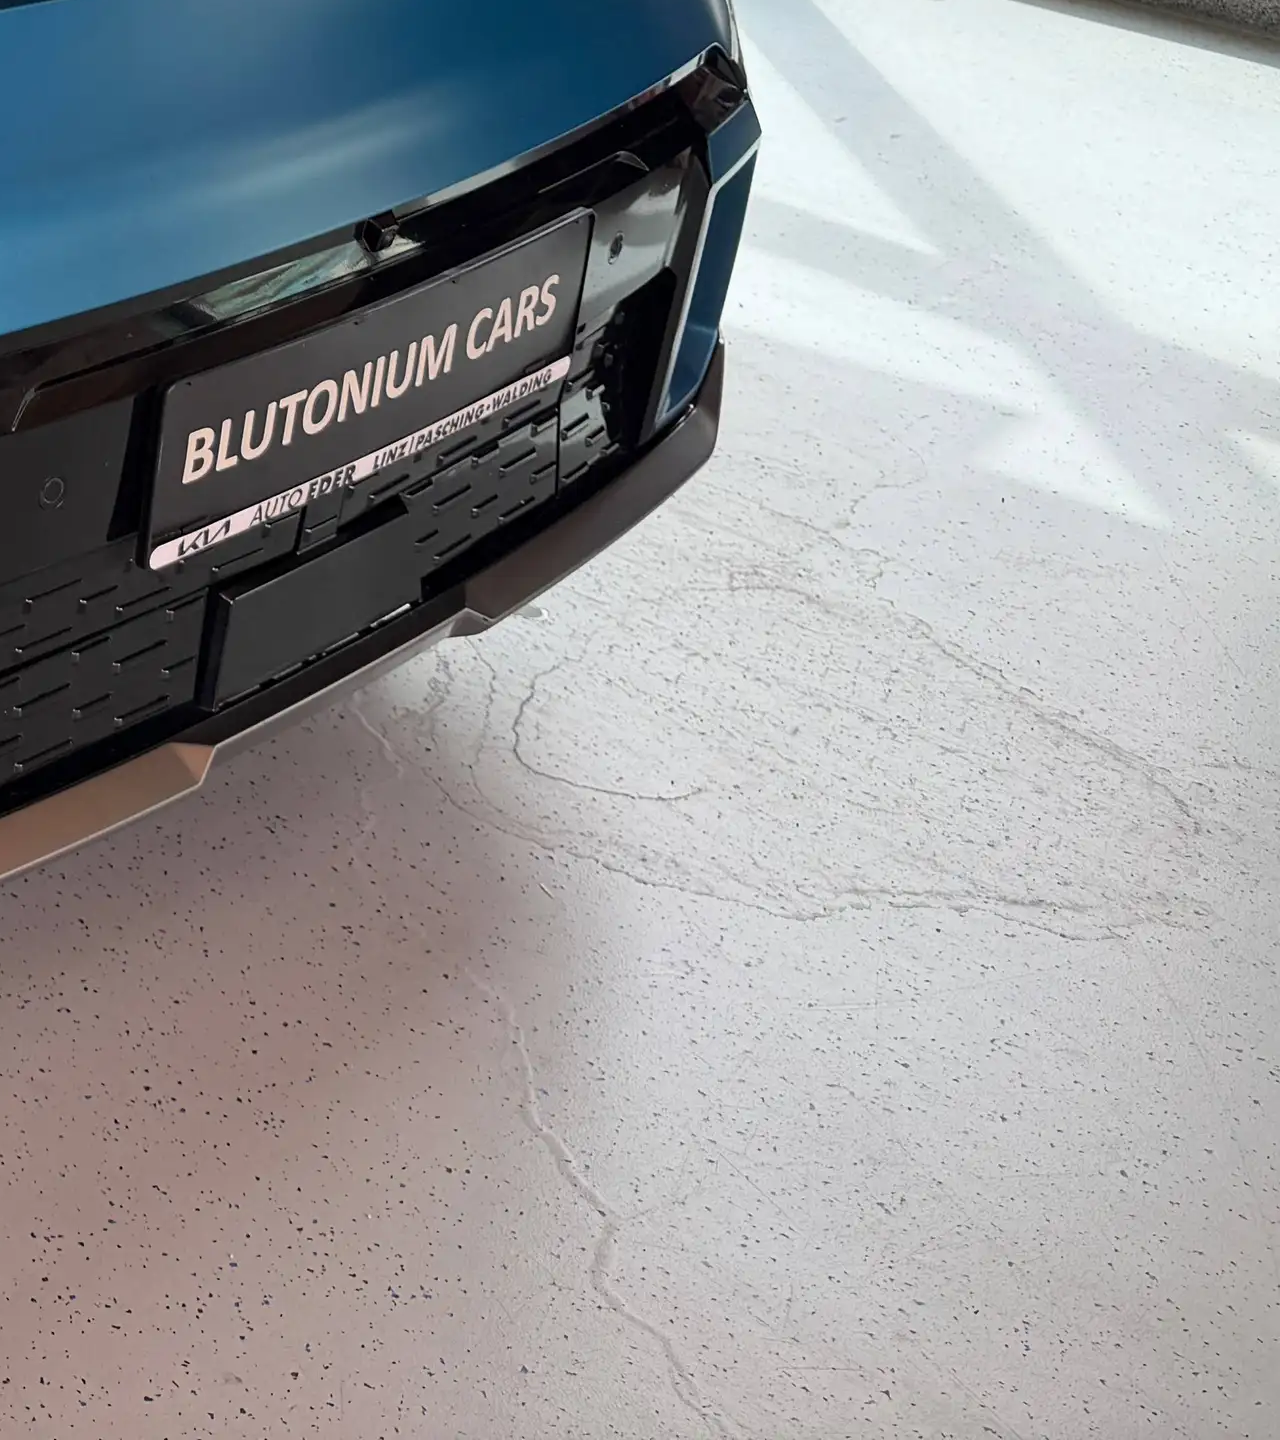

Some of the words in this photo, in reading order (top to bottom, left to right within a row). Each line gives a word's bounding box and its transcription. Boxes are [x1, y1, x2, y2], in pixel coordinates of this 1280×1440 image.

[182, 321, 458, 486] BLUTONIUM
[466, 274, 560, 360] CARS
[250, 488, 302, 526] AUTO
[308, 465, 357, 499] EDER
